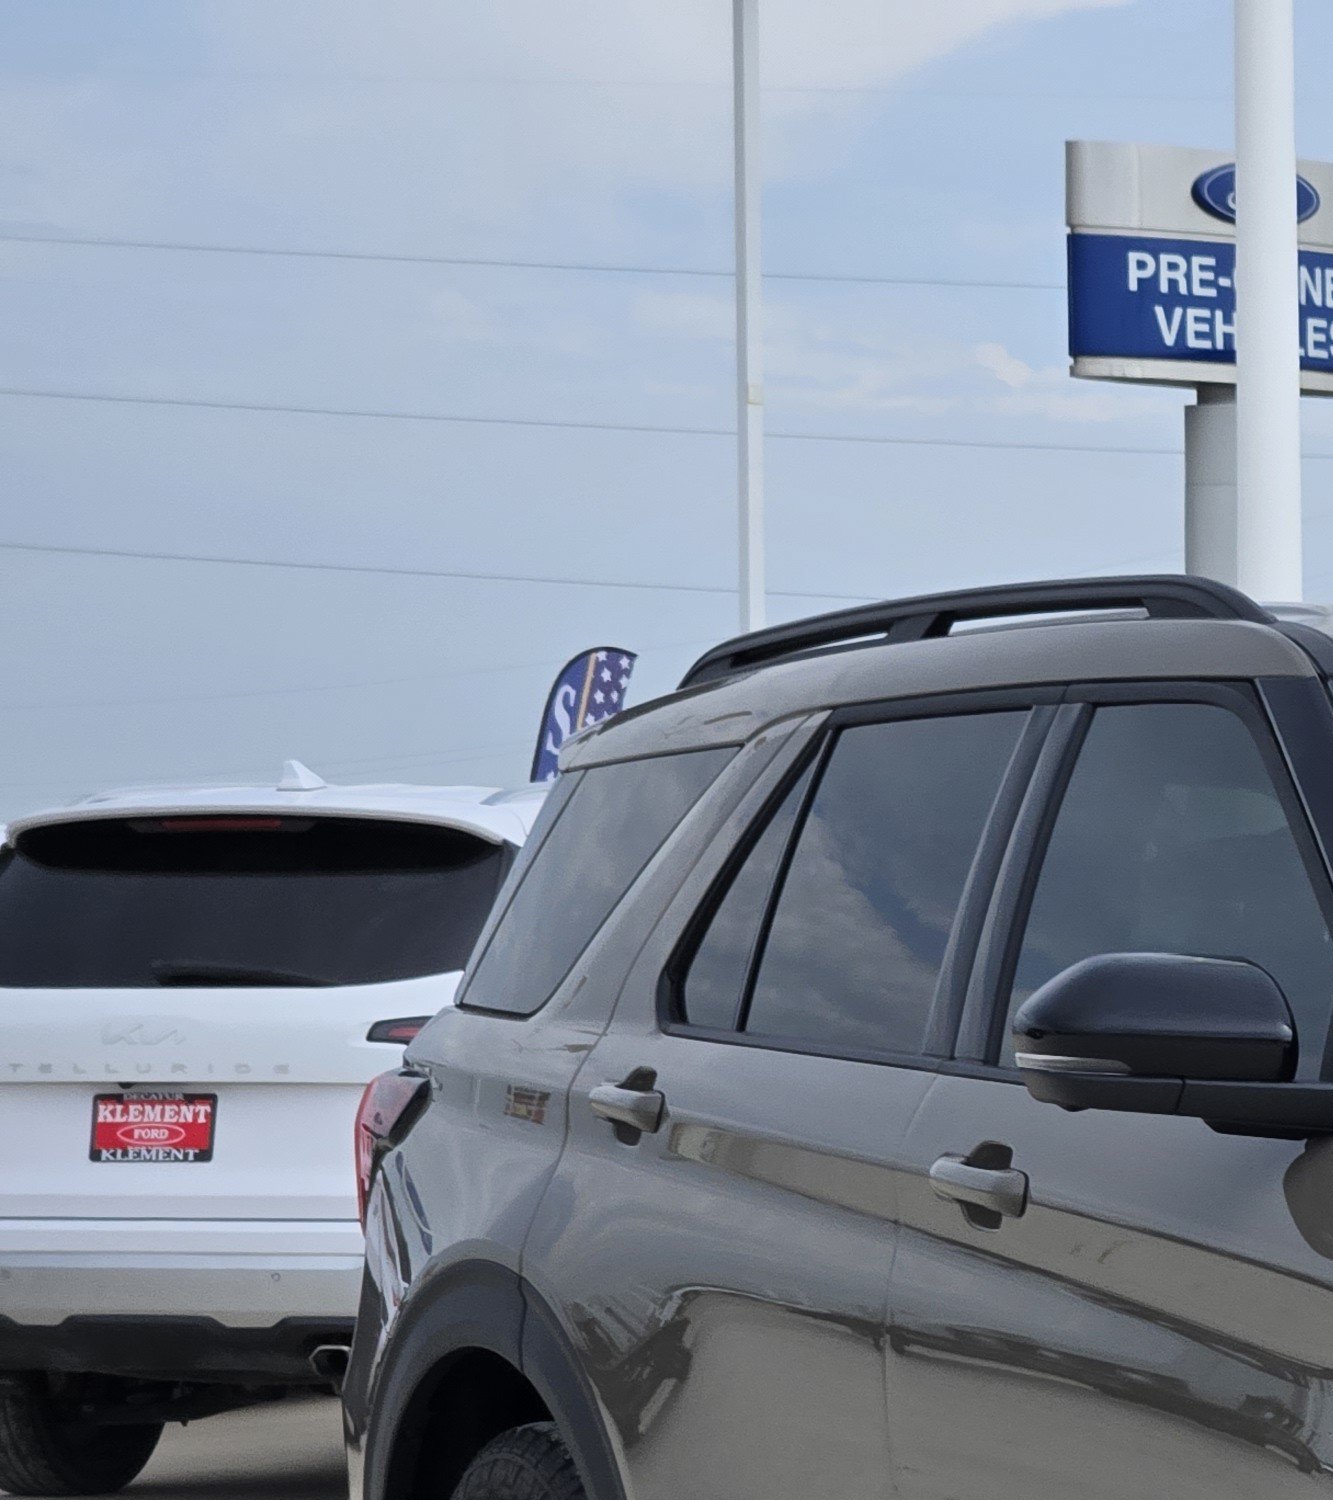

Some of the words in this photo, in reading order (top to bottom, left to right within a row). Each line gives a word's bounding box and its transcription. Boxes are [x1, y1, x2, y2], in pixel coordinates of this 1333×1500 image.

[8, 1062, 291, 1075] TELLURIDE
[97, 1103, 211, 1123] KLEMENT
[133, 1129, 170, 1139] FORD
[101, 1147, 199, 1161] KLEMENT
